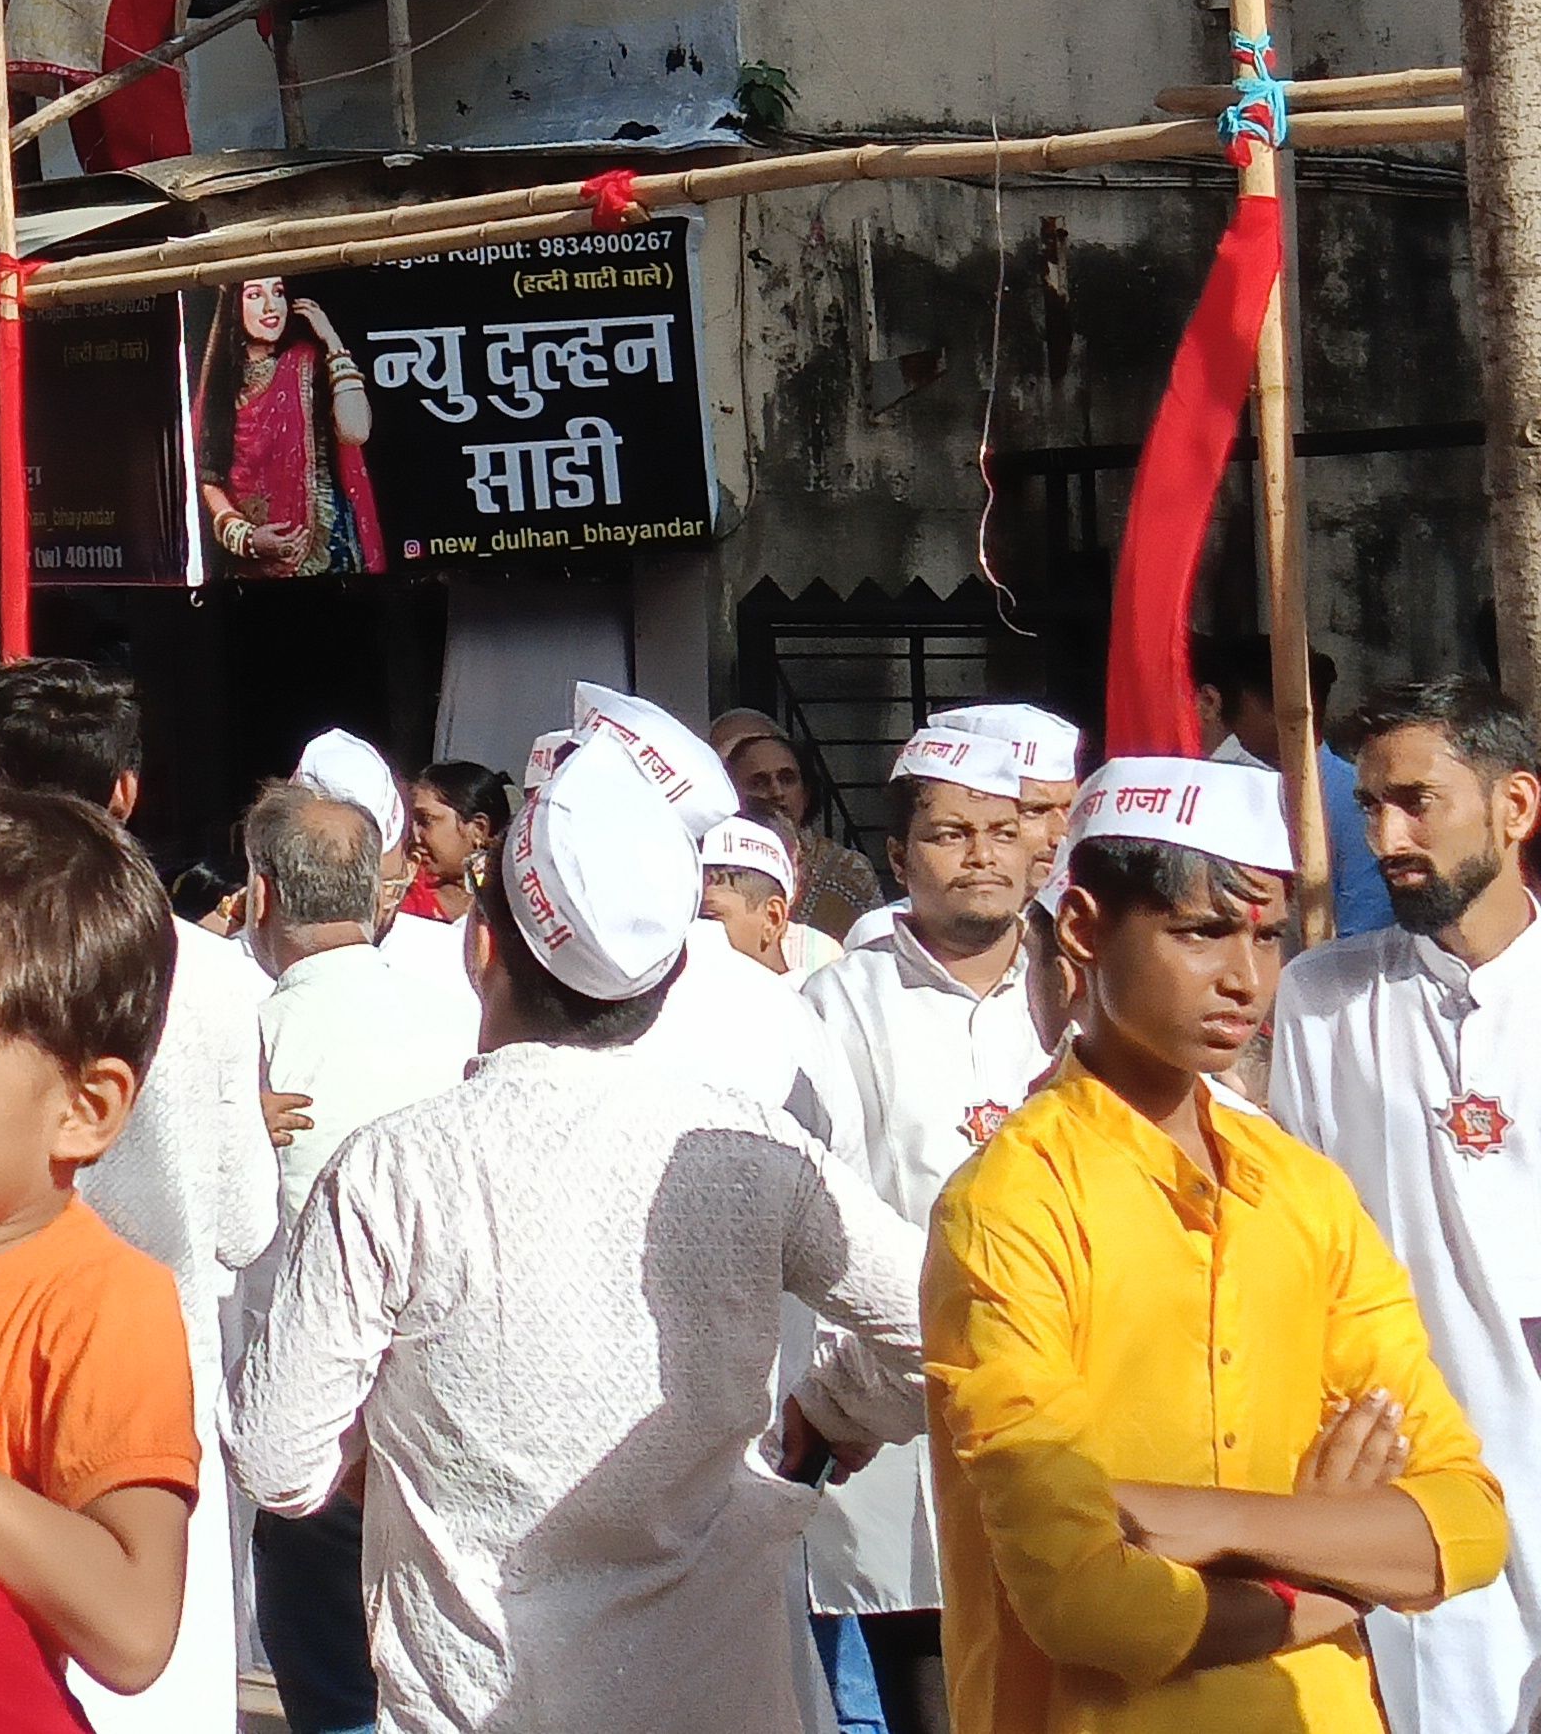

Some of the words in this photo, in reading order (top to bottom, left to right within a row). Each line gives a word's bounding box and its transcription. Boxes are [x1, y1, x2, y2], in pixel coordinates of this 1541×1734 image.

[448, 239, 531, 265] Rajput:
[539, 230, 673, 258] 9834900267
[366, 326, 478, 423] न्यु
[483, 314, 675, 419] दुल्हन
[462, 416, 623, 514] साडी
[65, 545, 123, 570] 401101
[430, 517, 704, 558] new_dulhan_bhayandar
[1116, 785, 1172, 815] राजा
[520, 865, 555, 925] राजा
